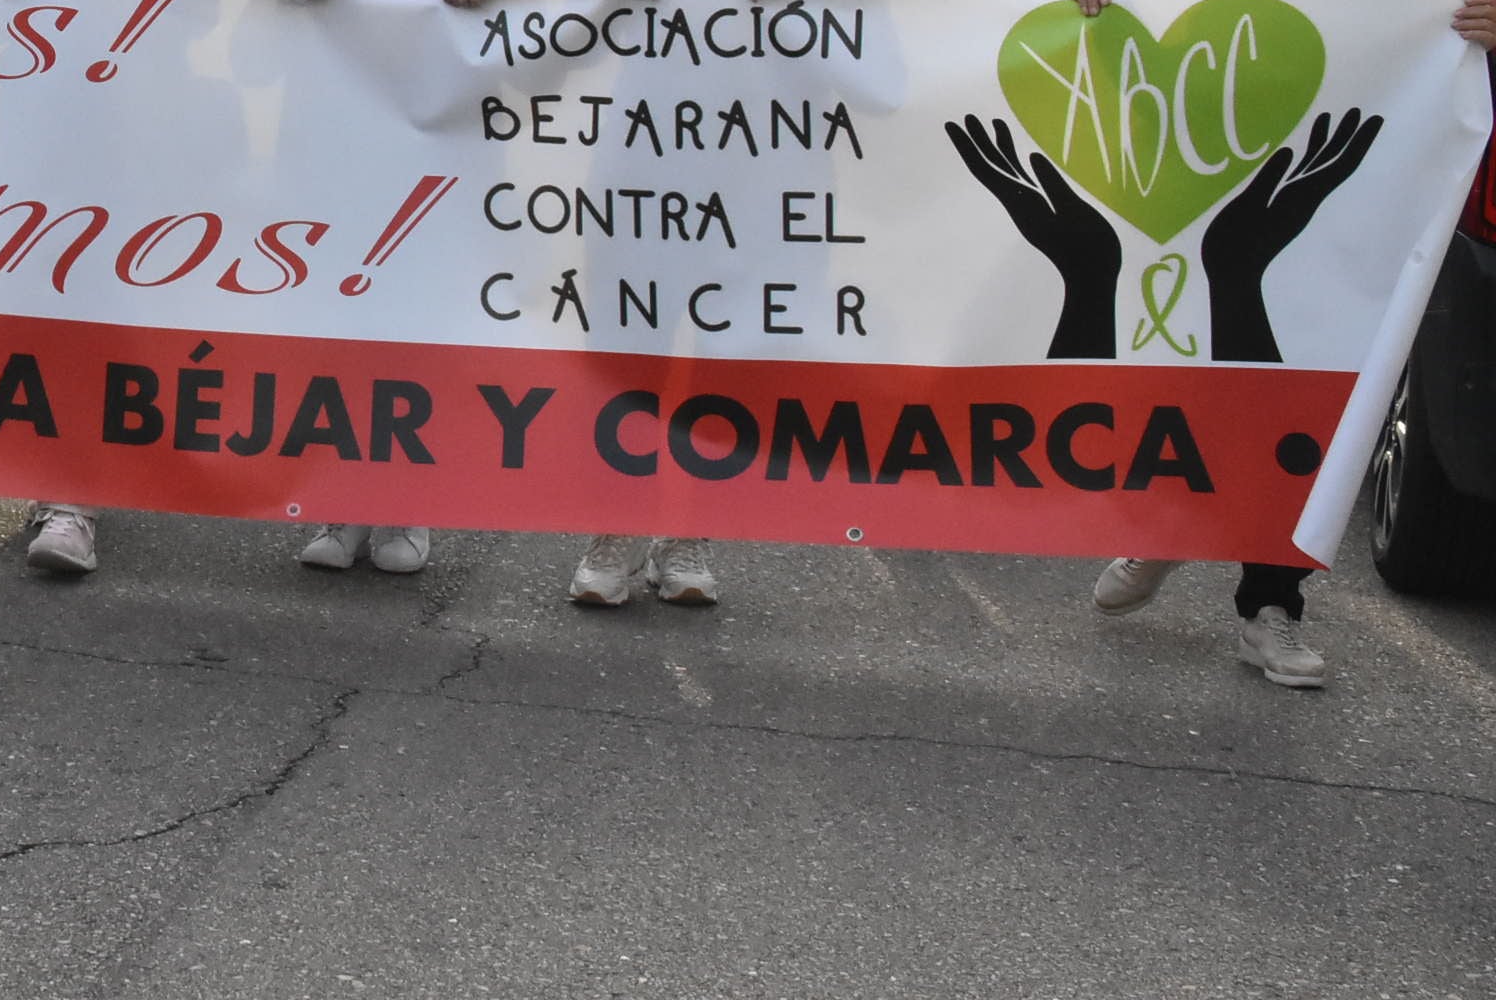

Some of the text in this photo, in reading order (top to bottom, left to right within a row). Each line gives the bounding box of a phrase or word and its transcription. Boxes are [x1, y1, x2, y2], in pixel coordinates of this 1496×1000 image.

[479, 0, 864, 67] ASOCIACIÓN
[480, 95, 864, 160] BEJARANA
[1017, 13, 1271, 198] ABCC
[483, 182, 867, 249] CONTRA EL
[480, 268, 868, 337] CÁNCER
[102, 339, 436, 466] BÉJAR
[476, 384, 556, 470] Y
[594, 389, 1216, 494] COMARCA
